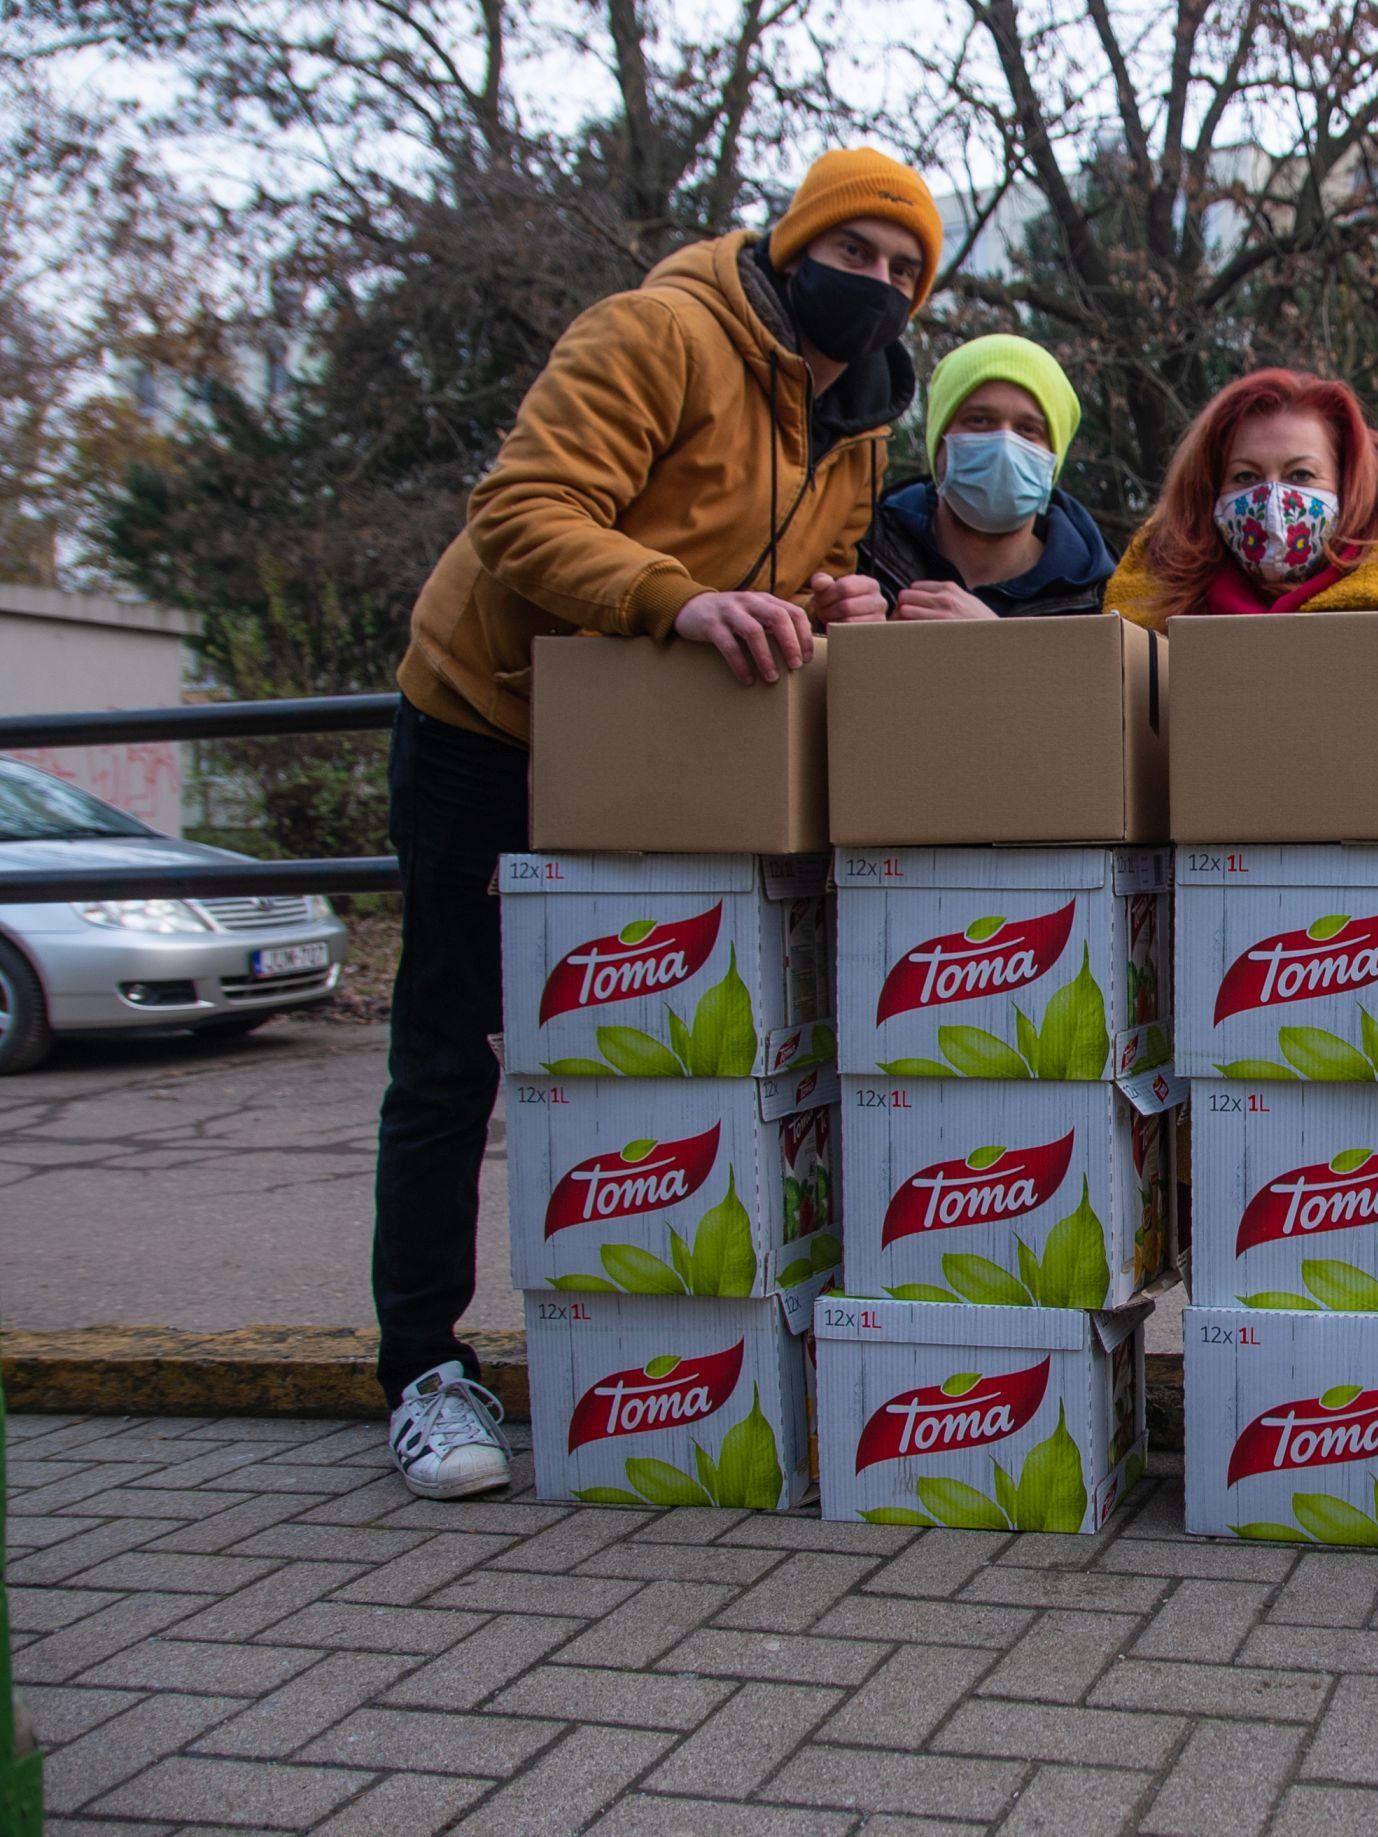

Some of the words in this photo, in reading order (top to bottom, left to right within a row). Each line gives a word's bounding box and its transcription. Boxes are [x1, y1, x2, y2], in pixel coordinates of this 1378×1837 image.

[510, 862, 540, 880] 12x
[545, 861, 565, 880] 1L
[846, 859, 877, 876] 12x
[883, 859, 904, 876] 1L
[1188, 854, 1221, 871] 12x
[1226, 854, 1249, 872] 1L
[567, 938, 689, 1004] Toma
[909, 936, 1038, 1003] Toma
[517, 1087, 546, 1103] 12x
[550, 1087, 571, 1104] 1L
[856, 1090, 886, 1107] 12x
[891, 1090, 912, 1108] 1L
[1209, 1094, 1242, 1112] 12x
[1248, 1094, 1270, 1112] 1L
[571, 1156, 689, 1220] Toma
[911, 1164, 1038, 1228] Toma
[538, 1303, 568, 1320] 12x
[571, 1303, 591, 1320] 1L
[824, 1309, 855, 1328] 12x
[860, 1311, 882, 1329] 1L
[1199, 1326, 1233, 1345] 12x
[1238, 1327, 1261, 1345] 1L
[595, 1373, 713, 1434] Toma
[886, 1391, 1015, 1454] Toma
